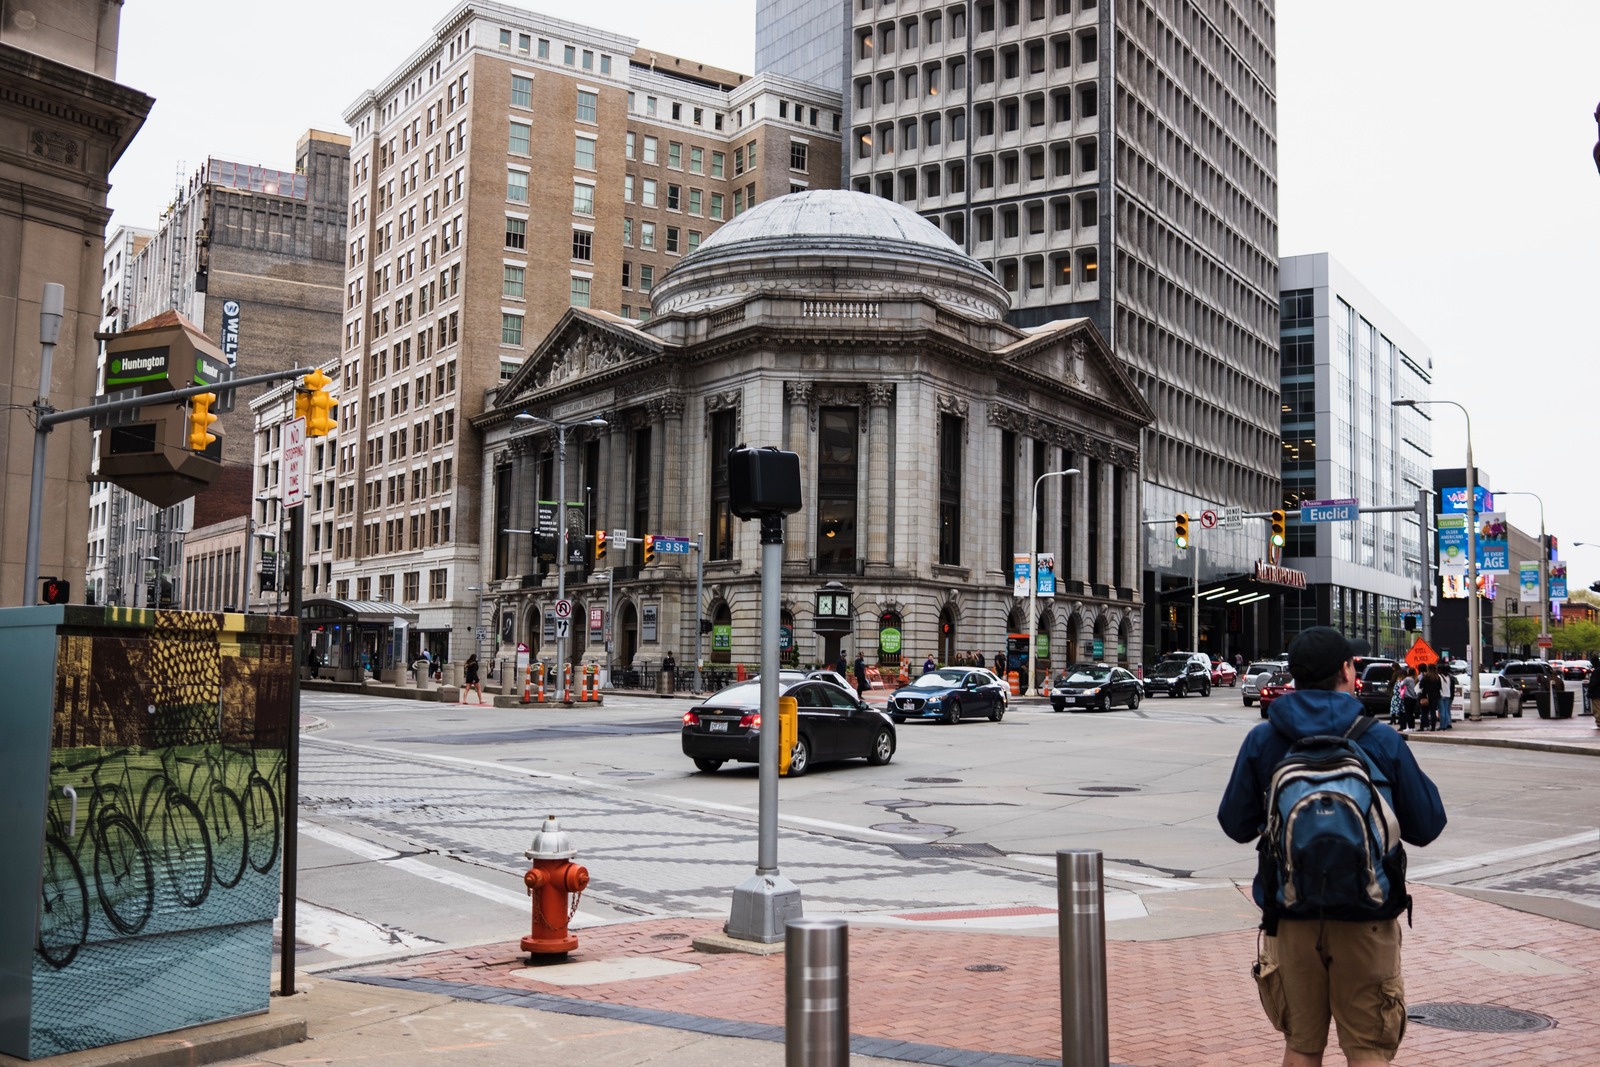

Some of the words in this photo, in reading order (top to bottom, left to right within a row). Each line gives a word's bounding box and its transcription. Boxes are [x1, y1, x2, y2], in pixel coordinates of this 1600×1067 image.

[122, 356, 165, 371] Huntington
[290, 428, 300, 446] NO
[286, 444, 304, 462] STOPPING
[290, 461, 298, 473] ANY
[290, 474, 299, 487] TIME
[1310, 507, 1348, 520] Euclid
[655, 542, 663, 551] E.
[666, 543, 671, 551] 9
[674, 543, 683, 552] St
[1484, 557, 1504, 568] AGE
[1256, 560, 1306, 588] METROPOLITAN
